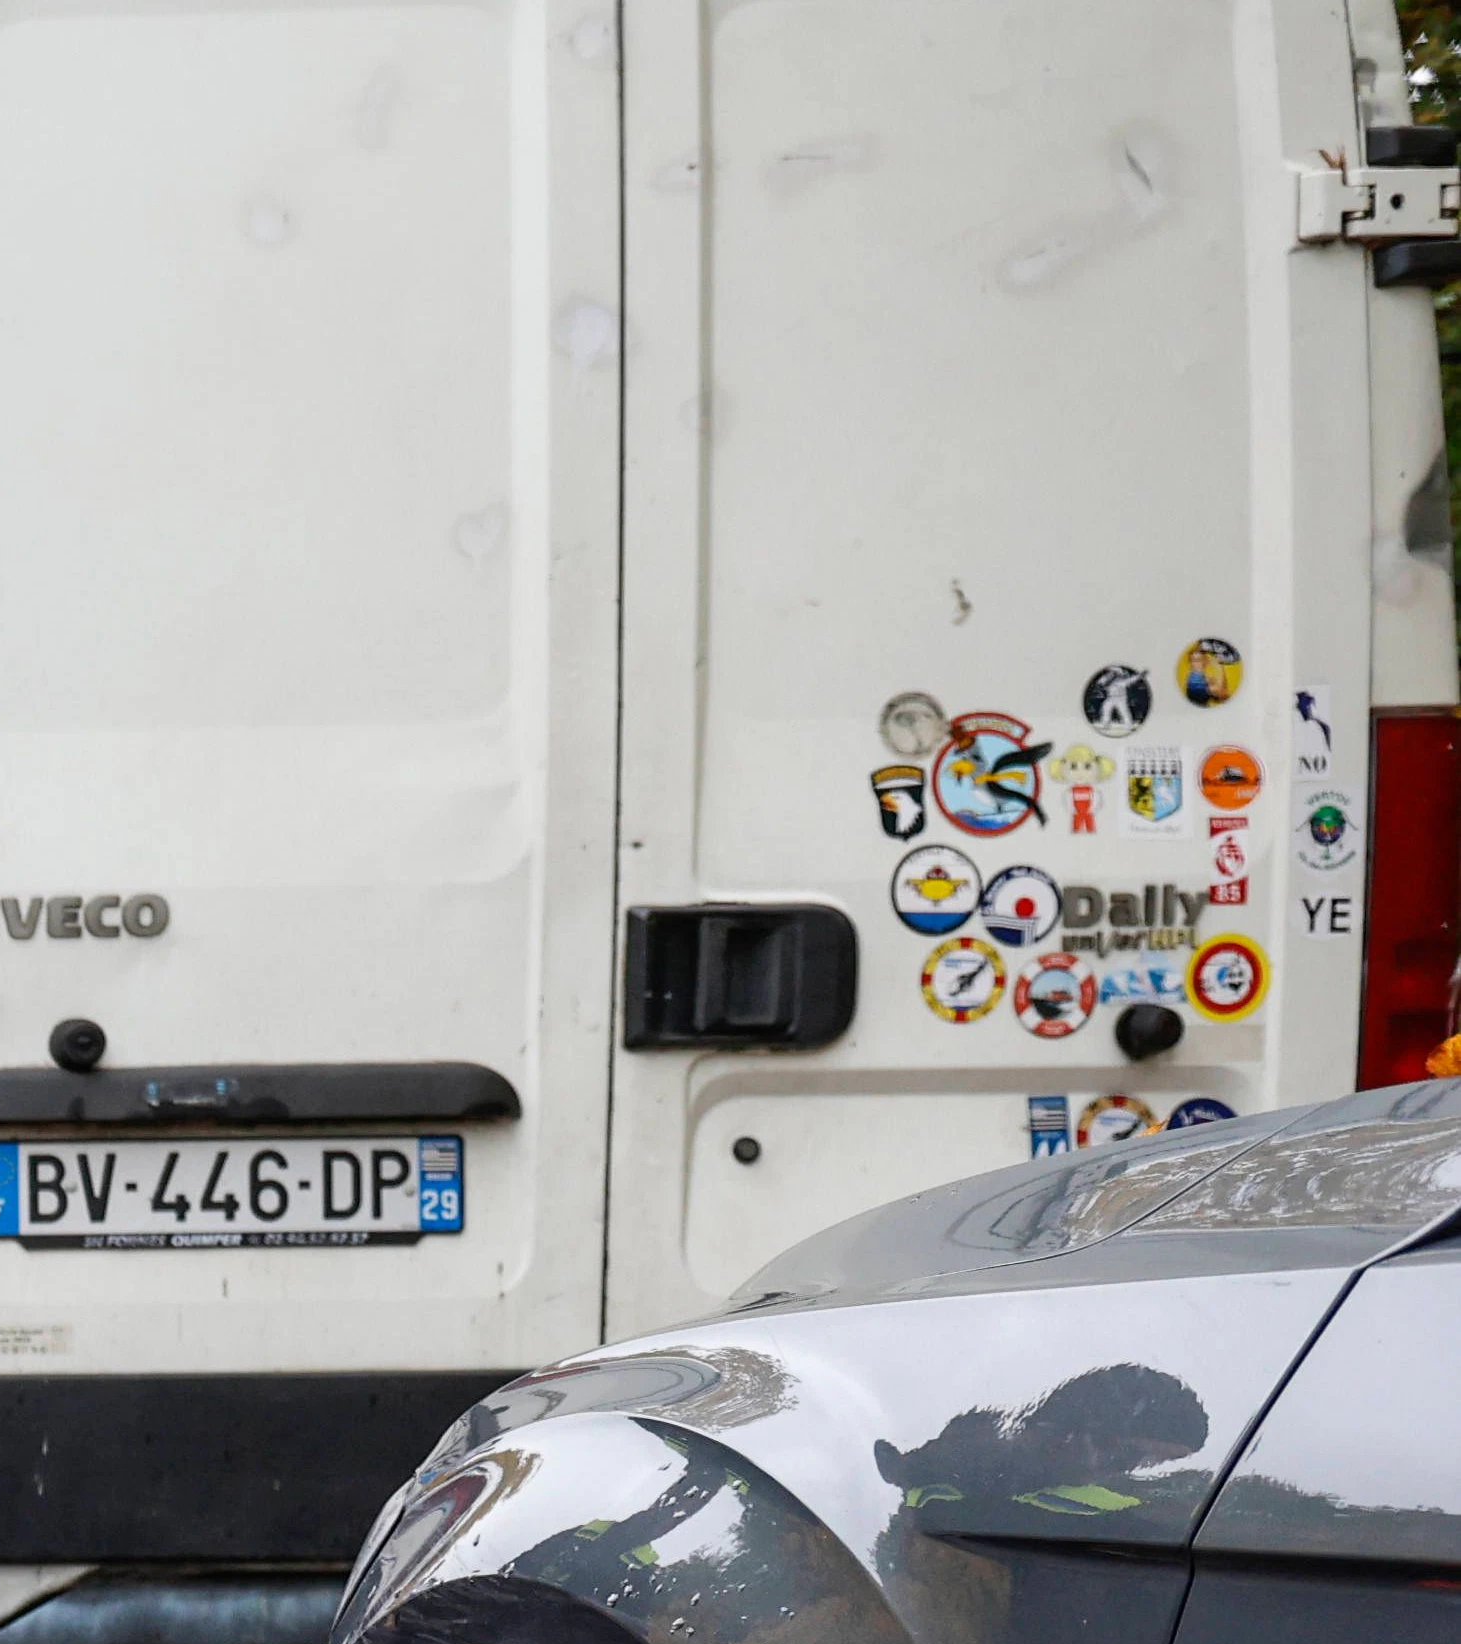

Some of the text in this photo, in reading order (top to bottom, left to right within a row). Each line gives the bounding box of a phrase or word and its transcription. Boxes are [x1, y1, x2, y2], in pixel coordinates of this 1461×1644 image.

[1063, 884, 1208, 928] Daily
[1302, 898, 1351, 934] YE
[27, 1149, 412, 1224] BV-446-DP
[422, 1189, 459, 1221] 29
